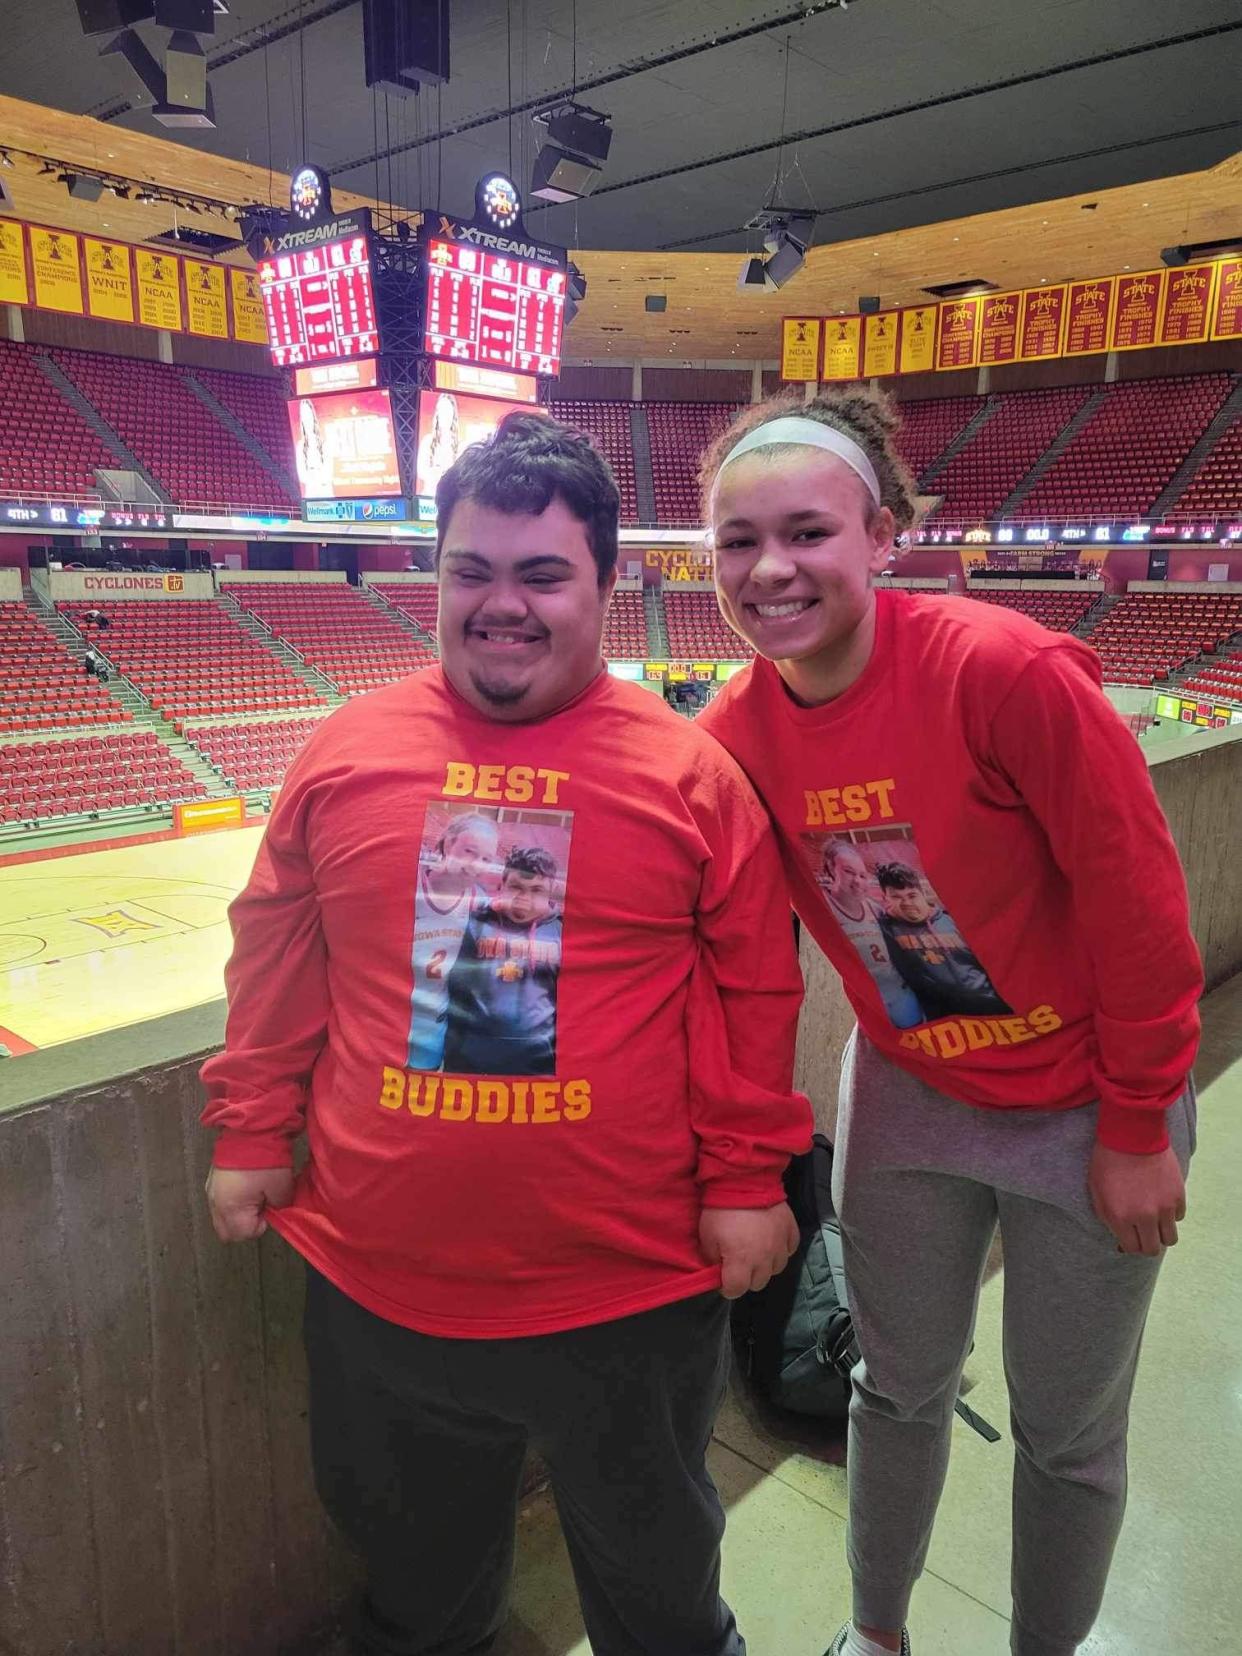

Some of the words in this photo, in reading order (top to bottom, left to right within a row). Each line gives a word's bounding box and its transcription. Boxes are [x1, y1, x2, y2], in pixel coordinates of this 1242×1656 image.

[277, 222, 338, 251] XTREAM
[458, 226, 536, 259] XTREAM
[92, 275, 128, 291] WNIT
[1172, 277, 1206, 292] STATE
[145, 287, 174, 300] NCAA
[1076, 290, 1106, 305] STATE
[1123, 283, 1156, 299] STATE
[193, 296, 221, 308] NCAA
[1029, 297, 1059, 311] STATE
[1172, 300, 1202, 310] TROPHY
[239, 304, 264, 316] NCAA
[987, 303, 1015, 317] STATE
[1075, 312, 1103, 321] TROPHY
[1123, 305, 1152, 315] TROPHY
[788, 348, 813, 356] NCAA
[830, 347, 855, 355] NCAA
[374, 504, 396, 518] pepsi
[645, 550, 714, 567] CYCLO
[84, 576, 164, 590] CYCLONES
[441, 761, 570, 805] BEST
[804, 778, 895, 826] BEST
[870, 943, 888, 963] 2
[426, 949, 448, 980] 2
[379, 1065, 592, 1124] BUDDIES
